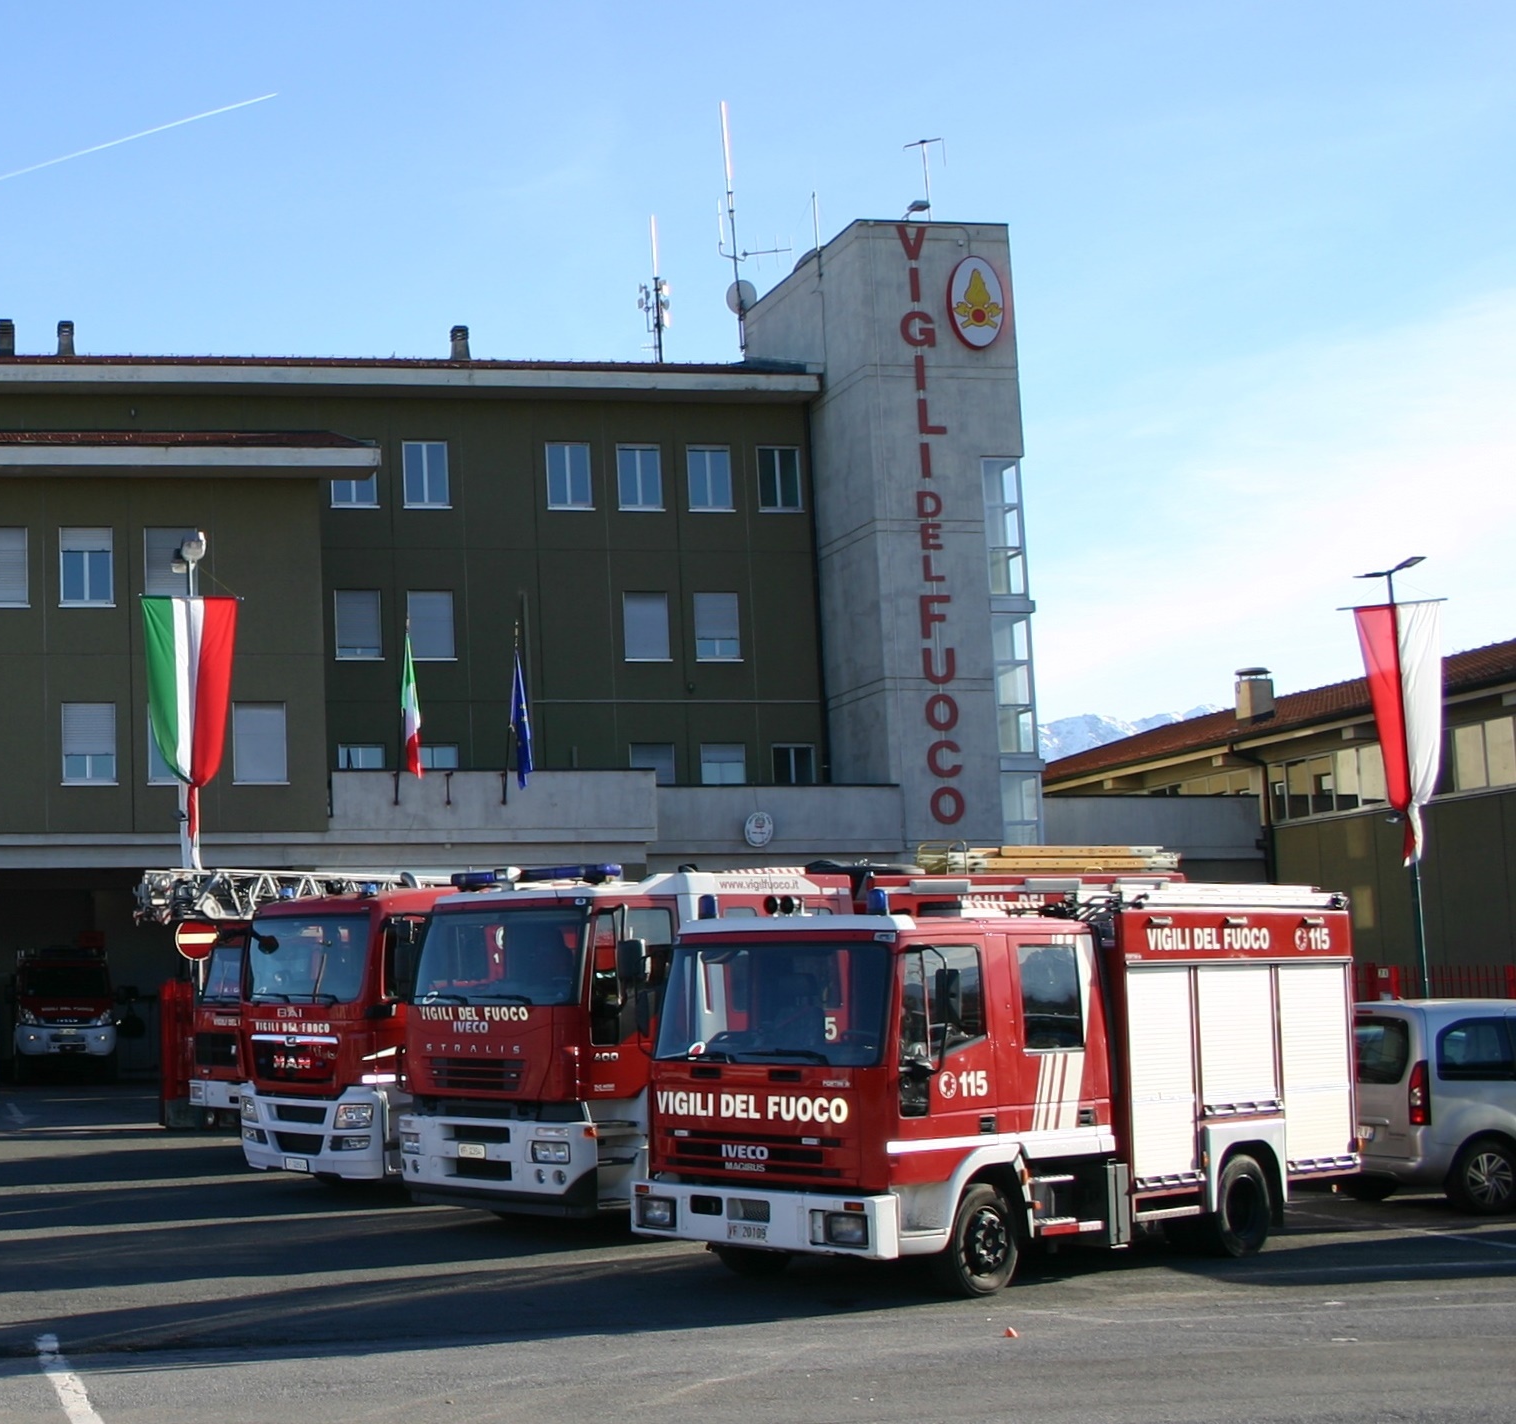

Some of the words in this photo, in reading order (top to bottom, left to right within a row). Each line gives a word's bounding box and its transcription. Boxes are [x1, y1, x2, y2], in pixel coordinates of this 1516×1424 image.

[896, 225, 948, 479] VIGILI
[917, 490, 946, 582] DEL
[919, 594, 966, 825] FUOCO
[1147, 928, 1190, 951] VIGILI
[1193, 928, 1221, 951] DEL
[1224, 927, 1270, 951] FUOCO
[1309, 928, 1330, 950] 115
[418, 1006, 454, 1021] VIGILI
[458, 1006, 480, 1021] DEL
[483, 1006, 529, 1021] FUOCO
[255, 1021, 280, 1032] VIGILI
[301, 1022, 331, 1034] FUOCO
[453, 1021, 489, 1033] IVECO
[425, 1043, 521, 1055] STRALIS
[273, 1055, 311, 1069] MAN
[959, 1070, 988, 1097] 115
[656, 1090, 715, 1117] VIGILI
[720, 1093, 762, 1120] DEL
[767, 1095, 849, 1124] FUOCO
[721, 1143, 769, 1160] IVECO
[724, 1161, 766, 1172] MAGIRUS
